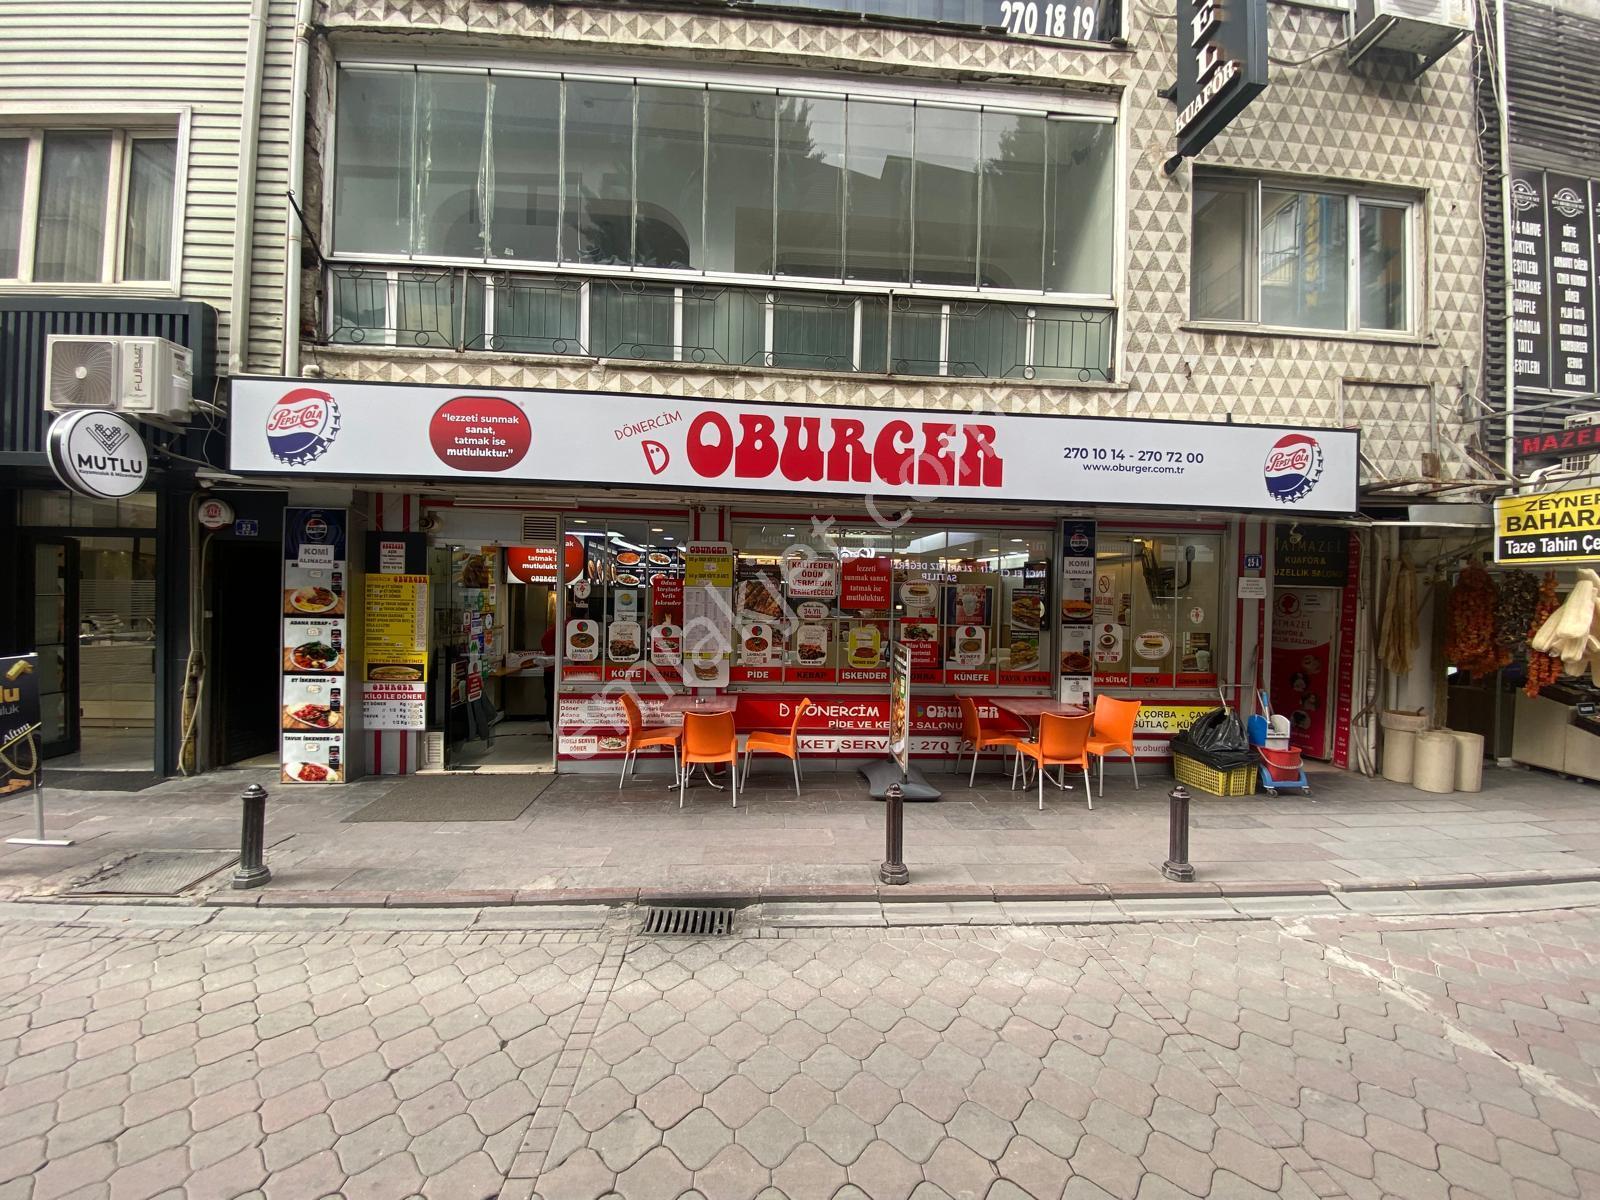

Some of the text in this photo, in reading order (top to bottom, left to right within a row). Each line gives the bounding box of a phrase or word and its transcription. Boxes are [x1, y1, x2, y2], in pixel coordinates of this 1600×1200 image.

[1000, 1, 1095, 41] 270 18 19
[479, 416, 519, 426] sunmak
[614, 410, 683, 441] DÖNERCİM
[465, 425, 496, 437] sanat,
[454, 436, 506, 447] tatmak ise
[686, 410, 1004, 488] OBURGER
[1062, 446, 1089, 460] 270
[1092, 448, 1108, 461] 10
[1110, 448, 1126, 462] 14
[1138, 449, 1163, 463] 270
[1166, 450, 1183, 464] 72
[1186, 451, 1204, 465] 00
[78, 453, 143, 474] MUTLU
[1082, 461, 1185, 475] www.oburger.com.tr
[1506, 540, 1536, 554] Taze
[1539, 536, 1577, 553] Tahin
[857, 564, 876, 573] lezzeti
[849, 584, 870, 592] tatmak
[746, 670, 769, 679] PİDE
[841, 670, 887, 680] İSKENDER
[953, 672, 989, 682] KÜNEFE
[1105, 675, 1128, 684] SÜTLAÇ
[396, 692, 422, 700] DÖNER
[926, 704, 1000, 718] OBUER
[1143, 710, 1177, 720] ÇORBA
[828, 719, 854, 729] PİDE
[857, 721, 872, 729] VE
[917, 721, 963, 730] SALONU
[1176, 721, 1197, 730] KÜN
[840, 740, 888, 751] SERV
[920, 740, 949, 753] 270
[955, 741, 974, 751] 72
